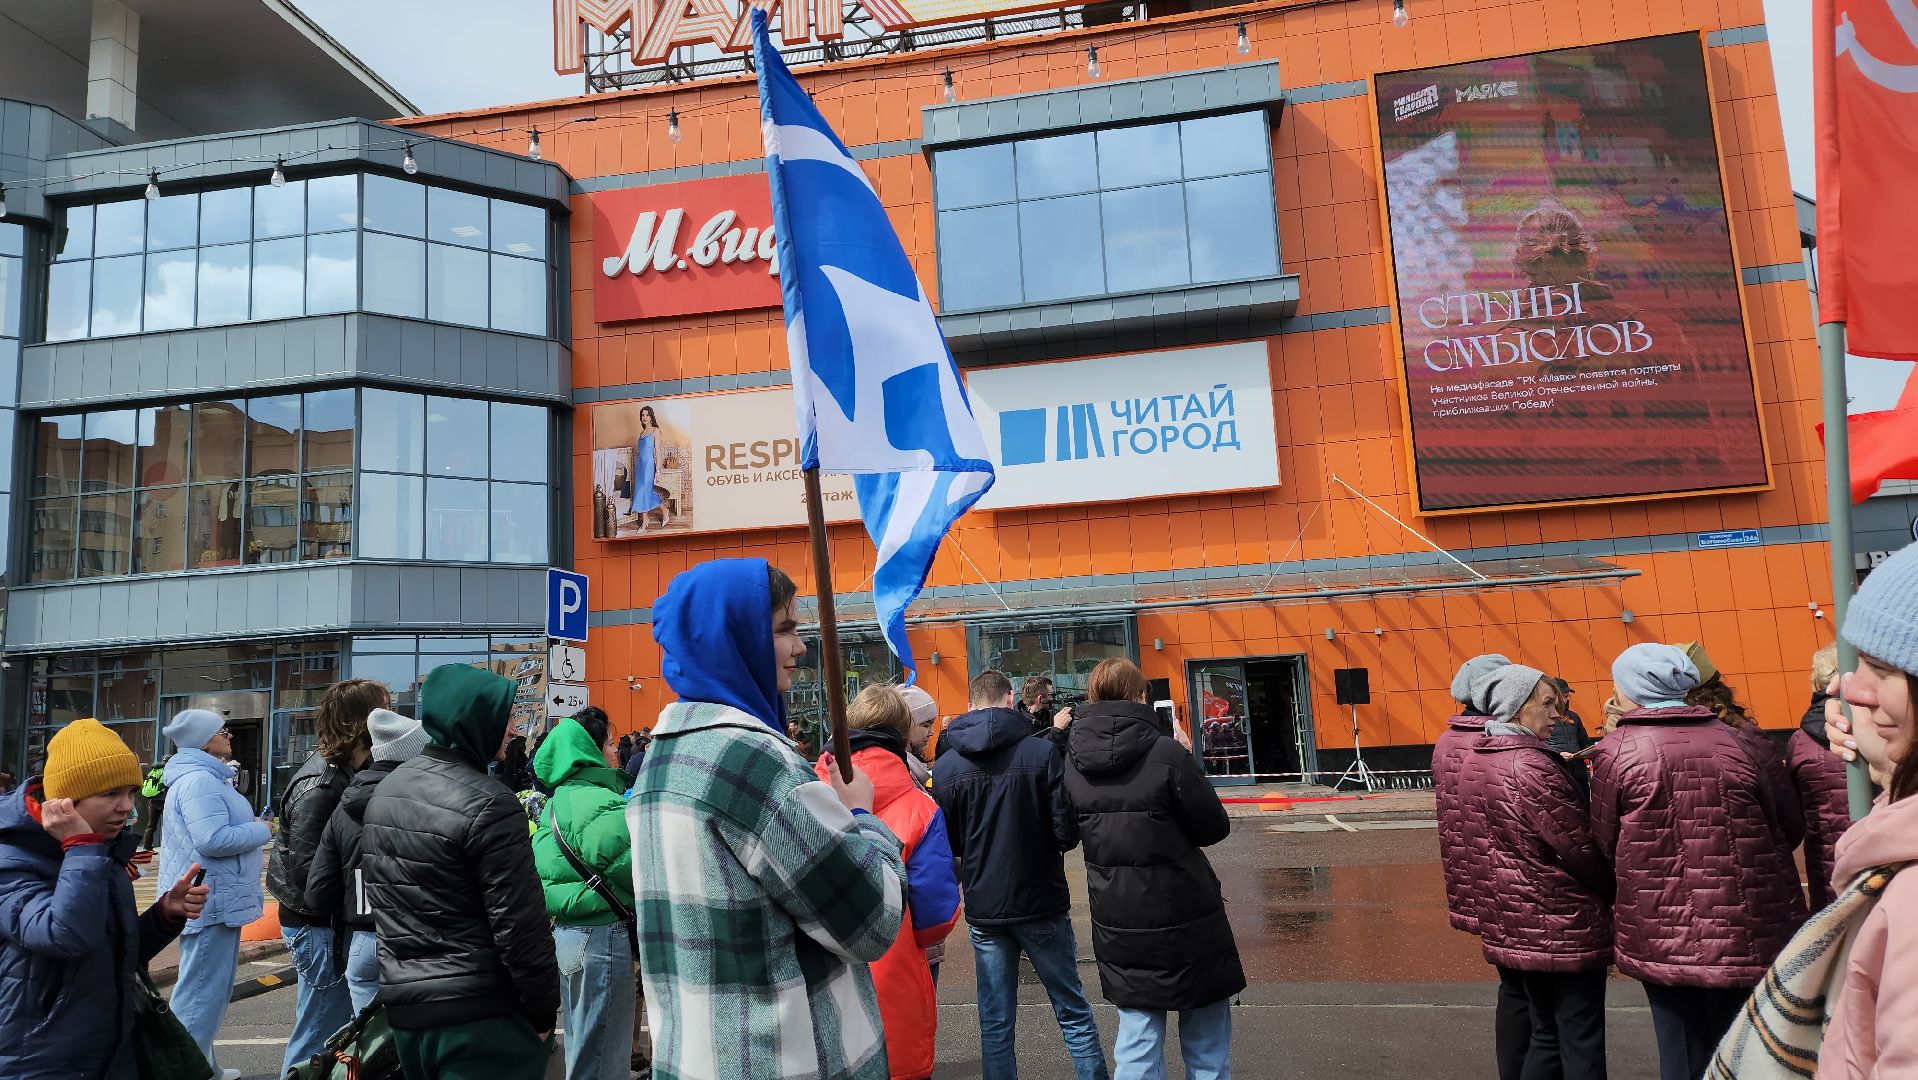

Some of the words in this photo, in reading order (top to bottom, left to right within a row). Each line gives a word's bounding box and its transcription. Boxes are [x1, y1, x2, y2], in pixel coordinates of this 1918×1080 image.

[1423, 320, 1653, 372] СМЫСЛОВ
[1430, 385, 1444, 394] На
[1446, 379, 1514, 392] медиафасаде
[1579, 368, 1627, 379] появятся
[1629, 363, 1681, 376] портреты
[1491, 387, 1535, 400] Великой
[1537, 379, 1619, 396] Отечественной
[1110, 383, 1236, 426] ЧИТАЙ
[1512, 398, 1555, 410] Победу!
[705, 437, 802, 472] RESP
[1112, 420, 1241, 457] ГОРОД
[706, 473, 750, 487] ОБУВЬ
[753, 472, 762, 482] И
[559, 578, 582, 631] P
